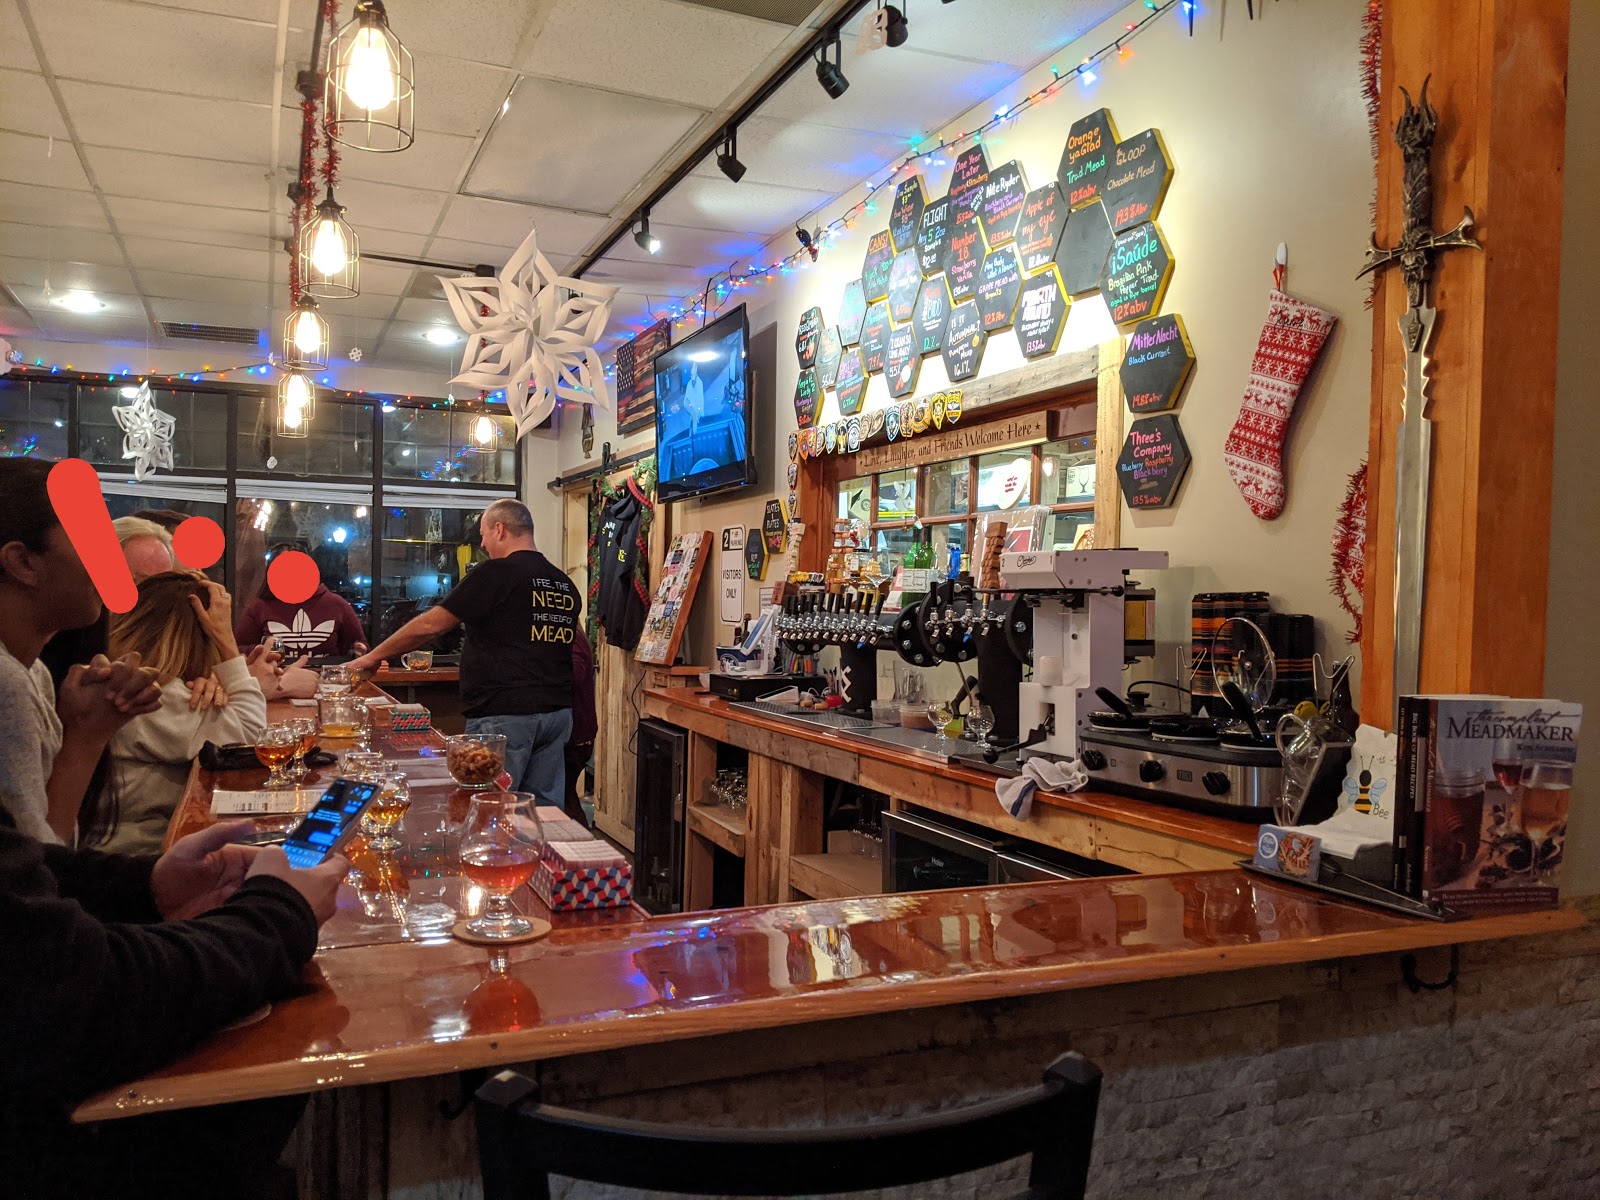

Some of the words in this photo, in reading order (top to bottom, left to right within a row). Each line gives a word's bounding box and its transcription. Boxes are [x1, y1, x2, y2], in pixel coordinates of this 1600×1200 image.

[1068, 127, 1099, 150] Orange
[954, 160, 968, 173] One
[968, 154, 982, 165] Year
[962, 164, 980, 180] Later
[1066, 165, 1084, 184] Trad
[1084, 155, 1106, 176] Mead
[1107, 170, 1135, 191] Chocolate
[1136, 160, 1156, 179] Mead
[1046, 192, 1054, 206] of
[923, 202, 949, 229] FLIGHT
[928, 228, 934, 243] 5
[934, 225, 946, 240] 2oz
[1022, 224, 1036, 242] my
[1039, 210, 1056, 234] eye
[869, 232, 889, 252] CANS!
[951, 232, 977, 252] Number
[957, 246, 970, 262] 18
[1108, 270, 1135, 292] Brazilian
[1136, 260, 1152, 276] Pink
[1128, 352, 1146, 366] Black
[1146, 346, 1170, 361] Currant
[884, 446, 916, 464] Laughter,
[918, 441, 932, 456] and
[934, 434, 963, 452] Friends
[964, 428, 1004, 447] Welcome
[1006, 422, 1032, 442] Here
[1130, 428, 1162, 446] Three's
[1133, 442, 1172, 458] Company
[1122, 461, 1143, 472] Blueberry
[1144, 455, 1174, 468] Raspberry
[723, 532, 729, 548] 2
[722, 569, 742, 580] VISITORS
[532, 578, 536, 587] I
[554, 581, 570, 592] THE
[726, 588, 737, 599] ONLY
[532, 590, 574, 611] NEED
[531, 625, 574, 644] MEAD
[1446, 717, 1574, 741] MEADMAKER
[1373, 802, 1389, 819] Bee
